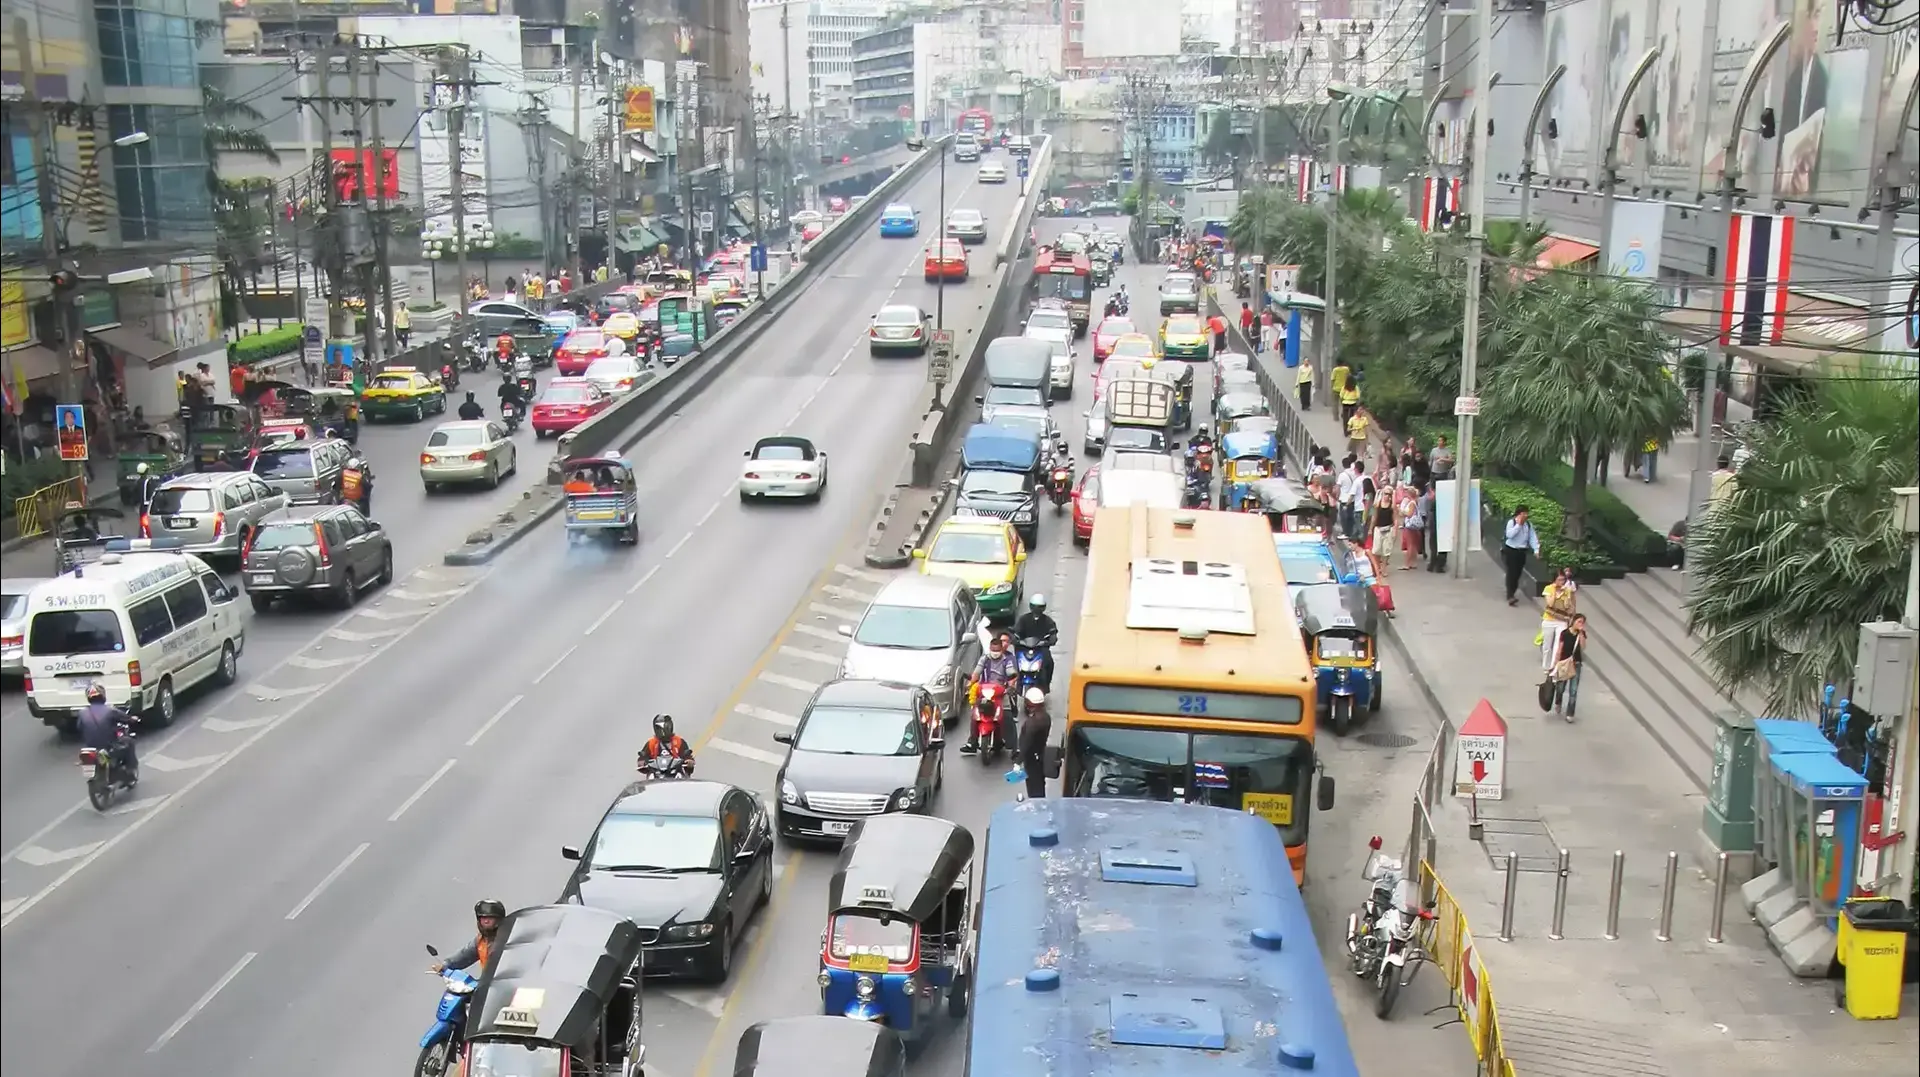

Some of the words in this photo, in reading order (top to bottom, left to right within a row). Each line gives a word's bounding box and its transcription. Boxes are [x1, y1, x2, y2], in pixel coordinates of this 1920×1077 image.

[73, 445, 86, 458] 30
[1178, 695, 1207, 713] 23
[1466, 750, 1495, 761] TAXI
[1821, 786, 1855, 797] TOT
[864, 888, 887, 899] TAXI
[502, 1011, 528, 1022] TAXI
